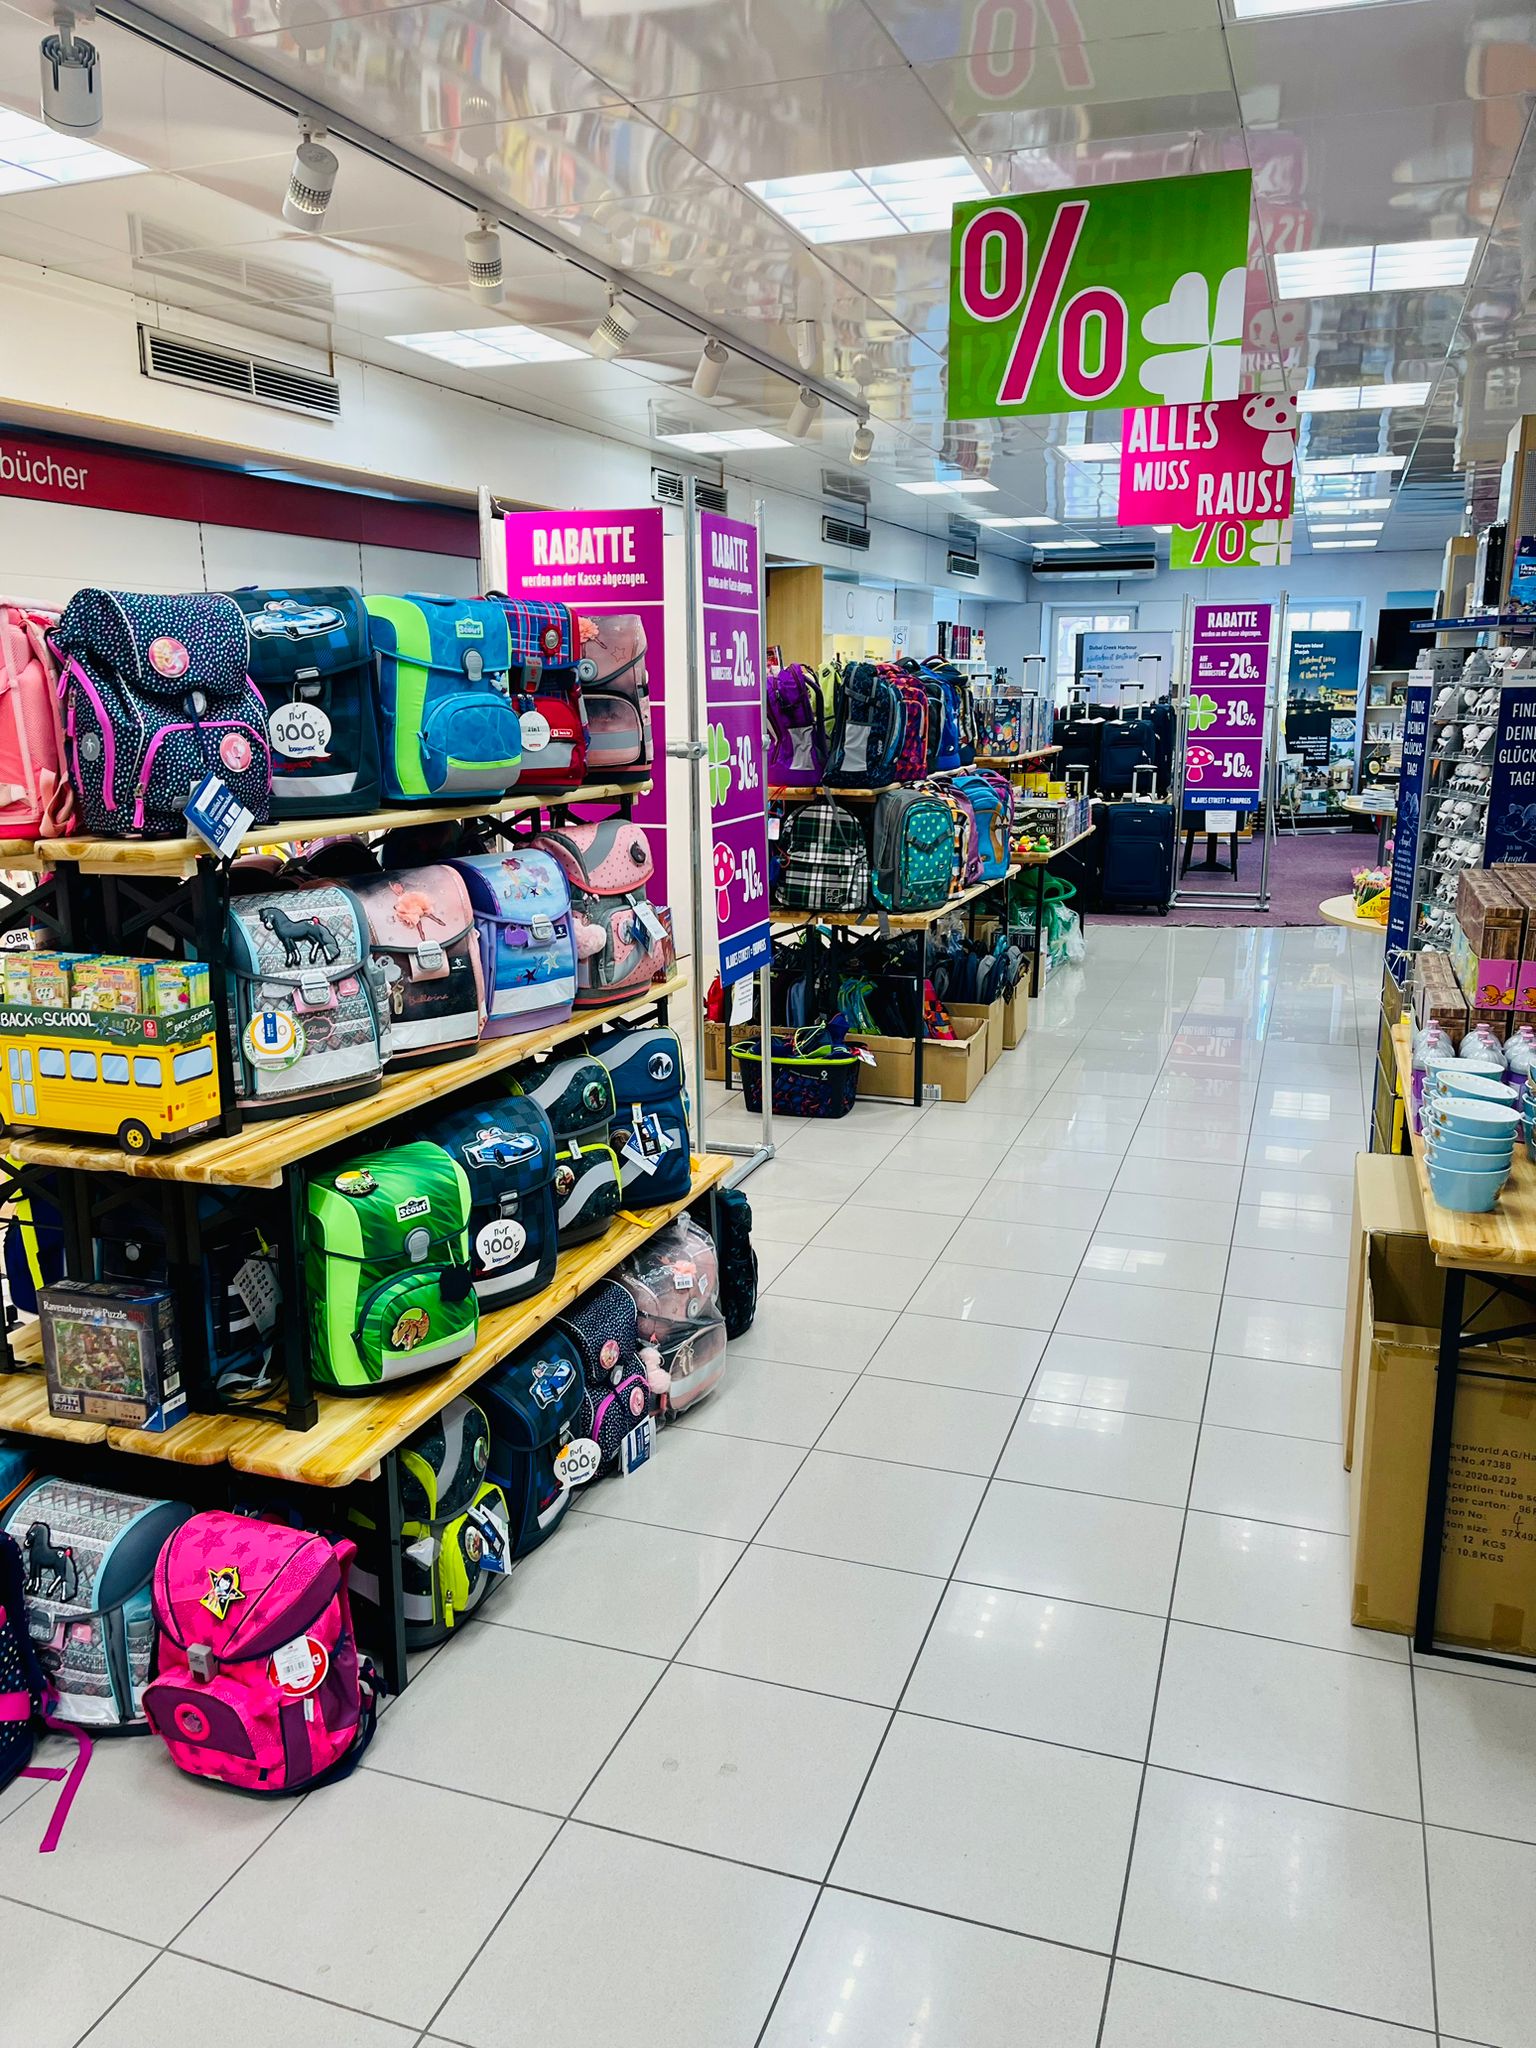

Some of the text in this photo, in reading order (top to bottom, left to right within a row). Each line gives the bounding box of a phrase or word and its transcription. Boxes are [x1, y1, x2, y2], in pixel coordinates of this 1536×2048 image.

[960, 200, 1129, 406] %
[1128, 403, 1219, 453] ALLES
[0, 447, 88, 490] bücher
[1132, 459, 1191, 492] MUSS
[1196, 470, 1285, 516] RAUS!
[533, 526, 636, 566] RABATTE
[711, 531, 749, 574] RABATTE
[522, 571, 648, 588] werden an der Kasse abgezogen.
[1207, 611, 1258, 628] RABATTE
[726, 630, 755, 687] -20%
[1219, 653, 1260, 679] -20%
[289, 711, 307, 721] nur
[1217, 700, 1256, 726] -30%
[1411, 700, 1426, 714] FINDE
[1407, 721, 1426, 735] DEINEN
[730, 735, 759, 791] -30%
[1213, 752, 1253, 778] -50%
[1509, 771, 1536, 786] TAG!
[735, 847, 764, 902] -50%
[6, 932, 28, 944] OBR
[0, 1011, 95, 1027] BACK TO SCHOOL
[174, 1019, 188, 1032] BACK
[191, 1008, 212, 1023] SCHOOL
[399, 1202, 428, 1218] Scout
[494, 1226, 509, 1236] nur
[43, 1301, 95, 1319] Ravensburger
[102, 1308, 127, 1320] Puzzle
[570, 1445, 583, 1457] nur
[1500, 1489, 1524, 1500] tube
[1471, 1498, 1511, 1511] carton:
[1463, 1535, 1474, 1544] 12
[1482, 1539, 1507, 1550] KGS
